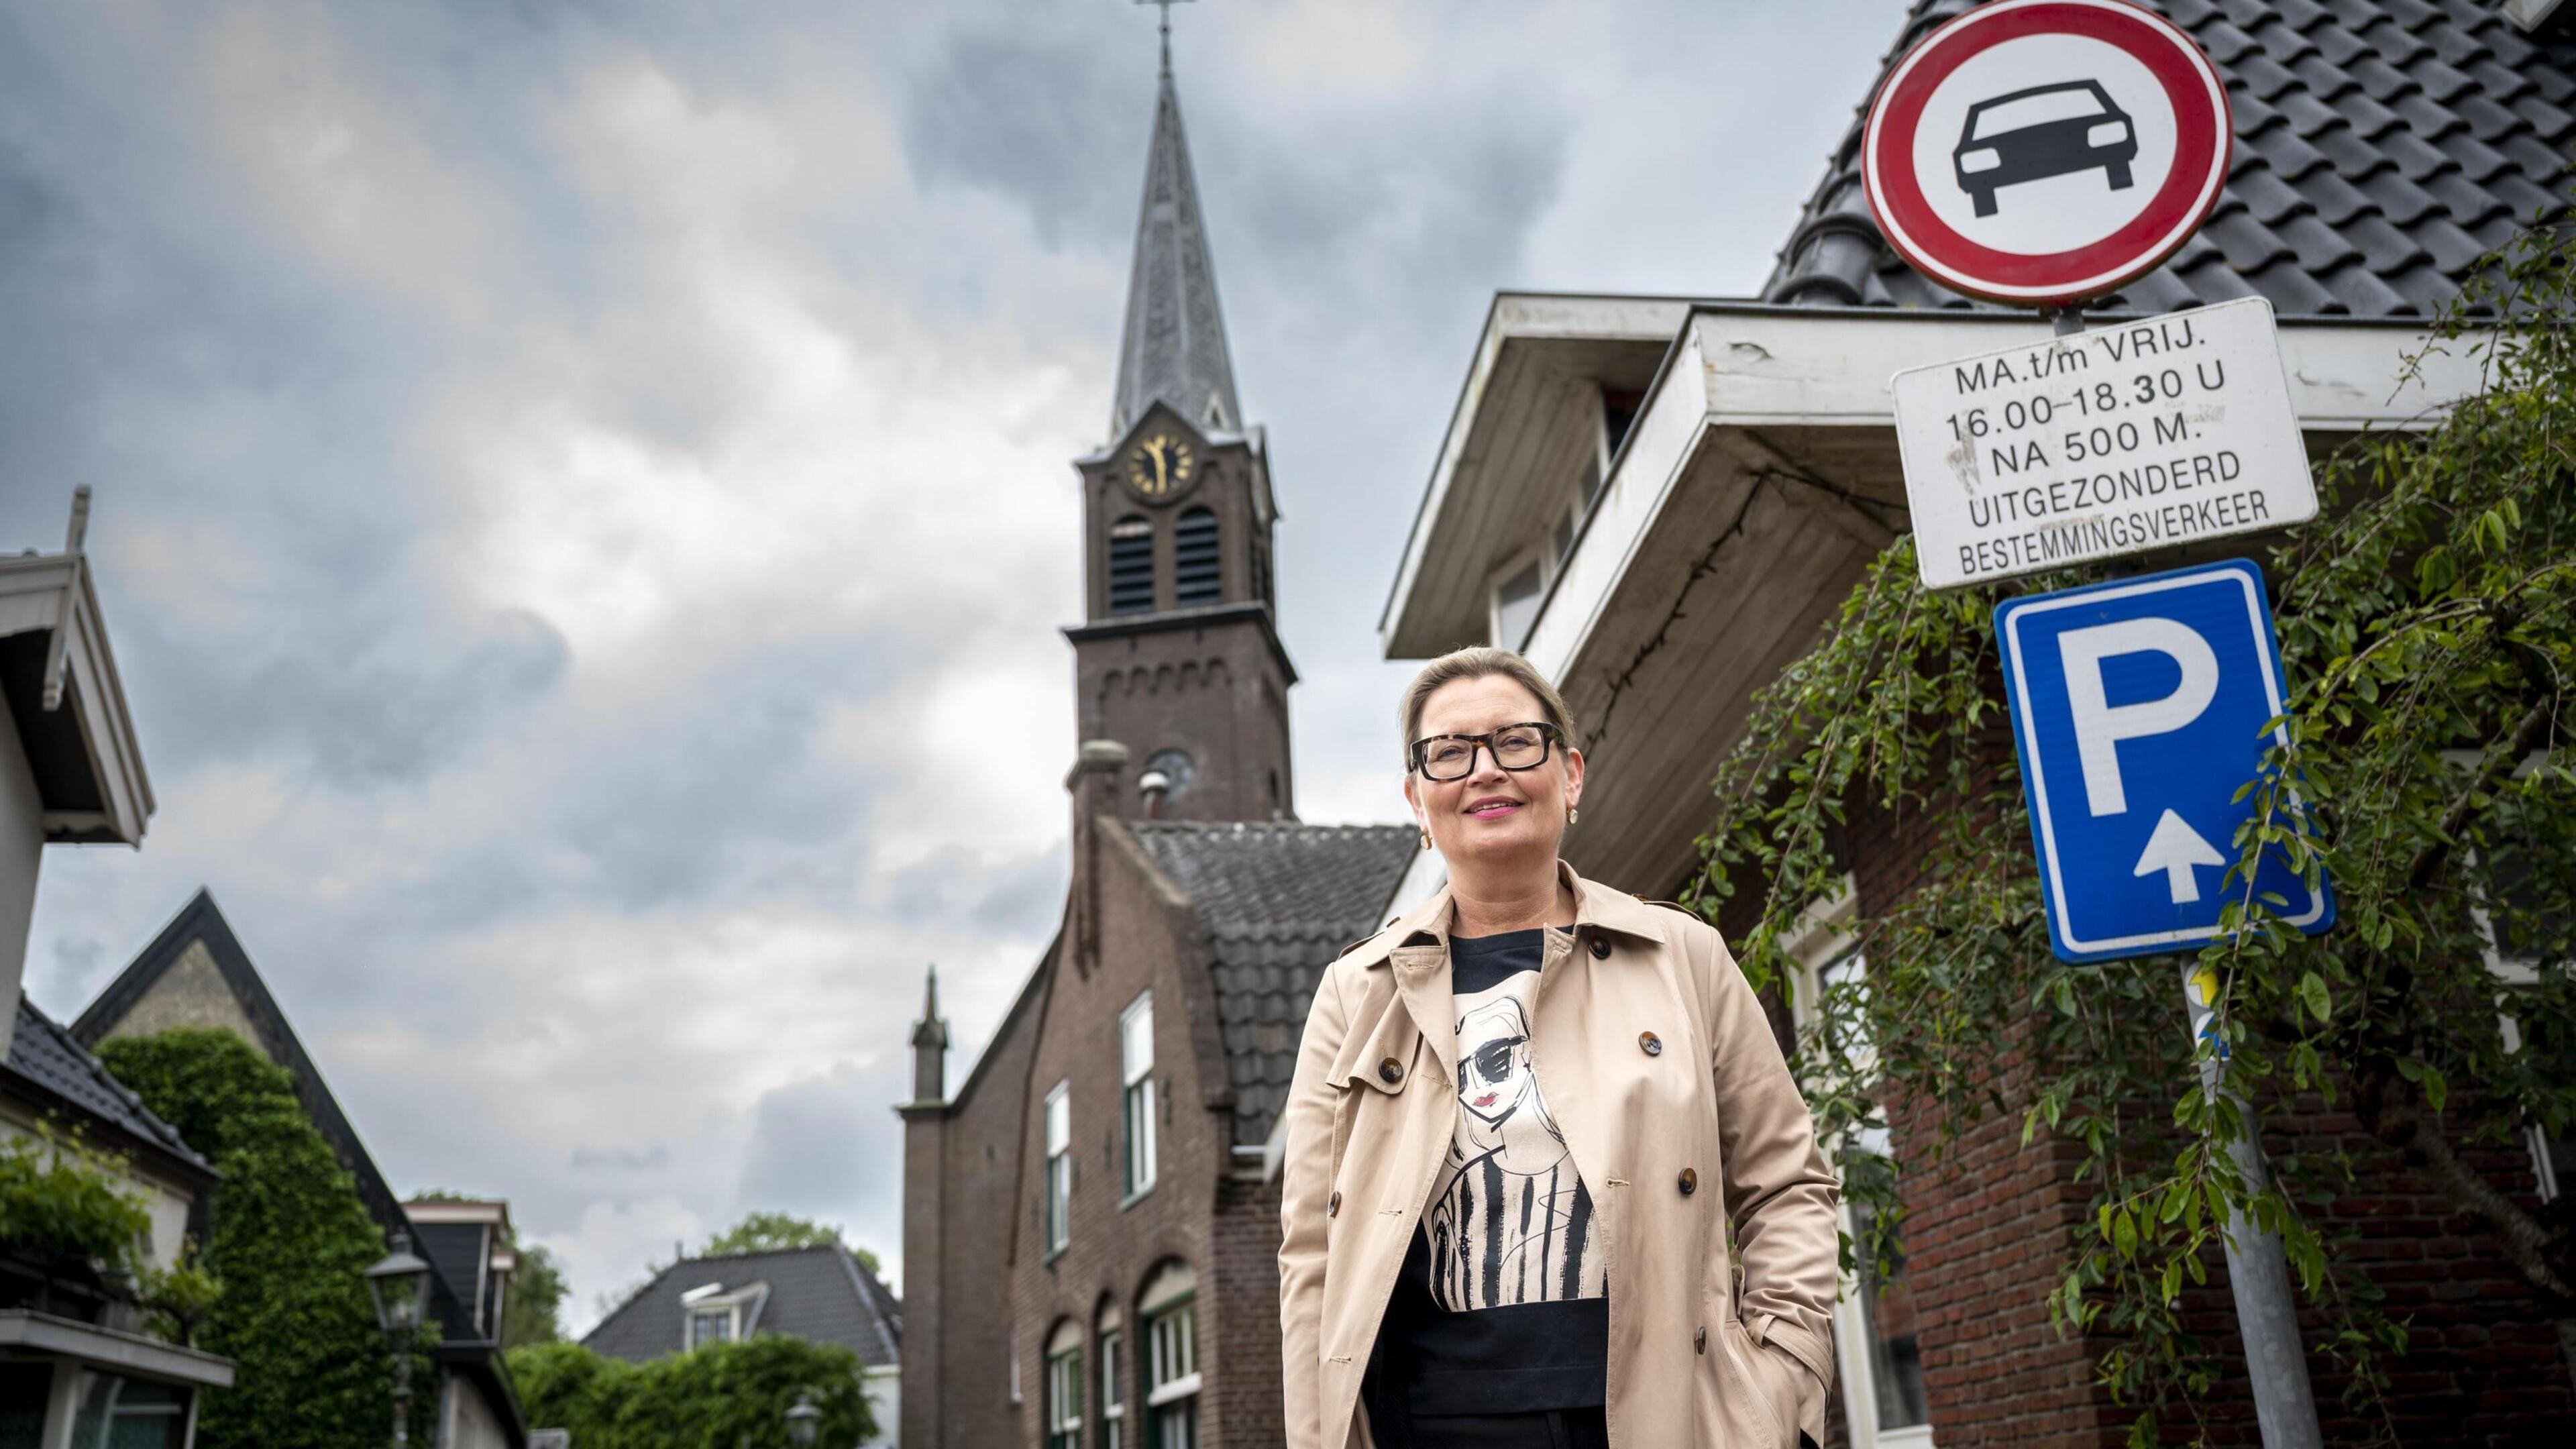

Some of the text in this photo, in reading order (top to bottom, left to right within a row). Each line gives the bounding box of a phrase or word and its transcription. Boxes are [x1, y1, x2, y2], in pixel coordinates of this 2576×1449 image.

[1955, 318, 2206, 395] MA.t/m VRIJ.
[2196, 359, 2225, 391] U
[1991, 411, 2202, 476] NA 500 M.
[1969, 451, 2241, 528] UITGEZONDERD
[1960, 490, 2269, 575] BESTEMMINGSVERKEER
[2057, 616, 2220, 818] P
